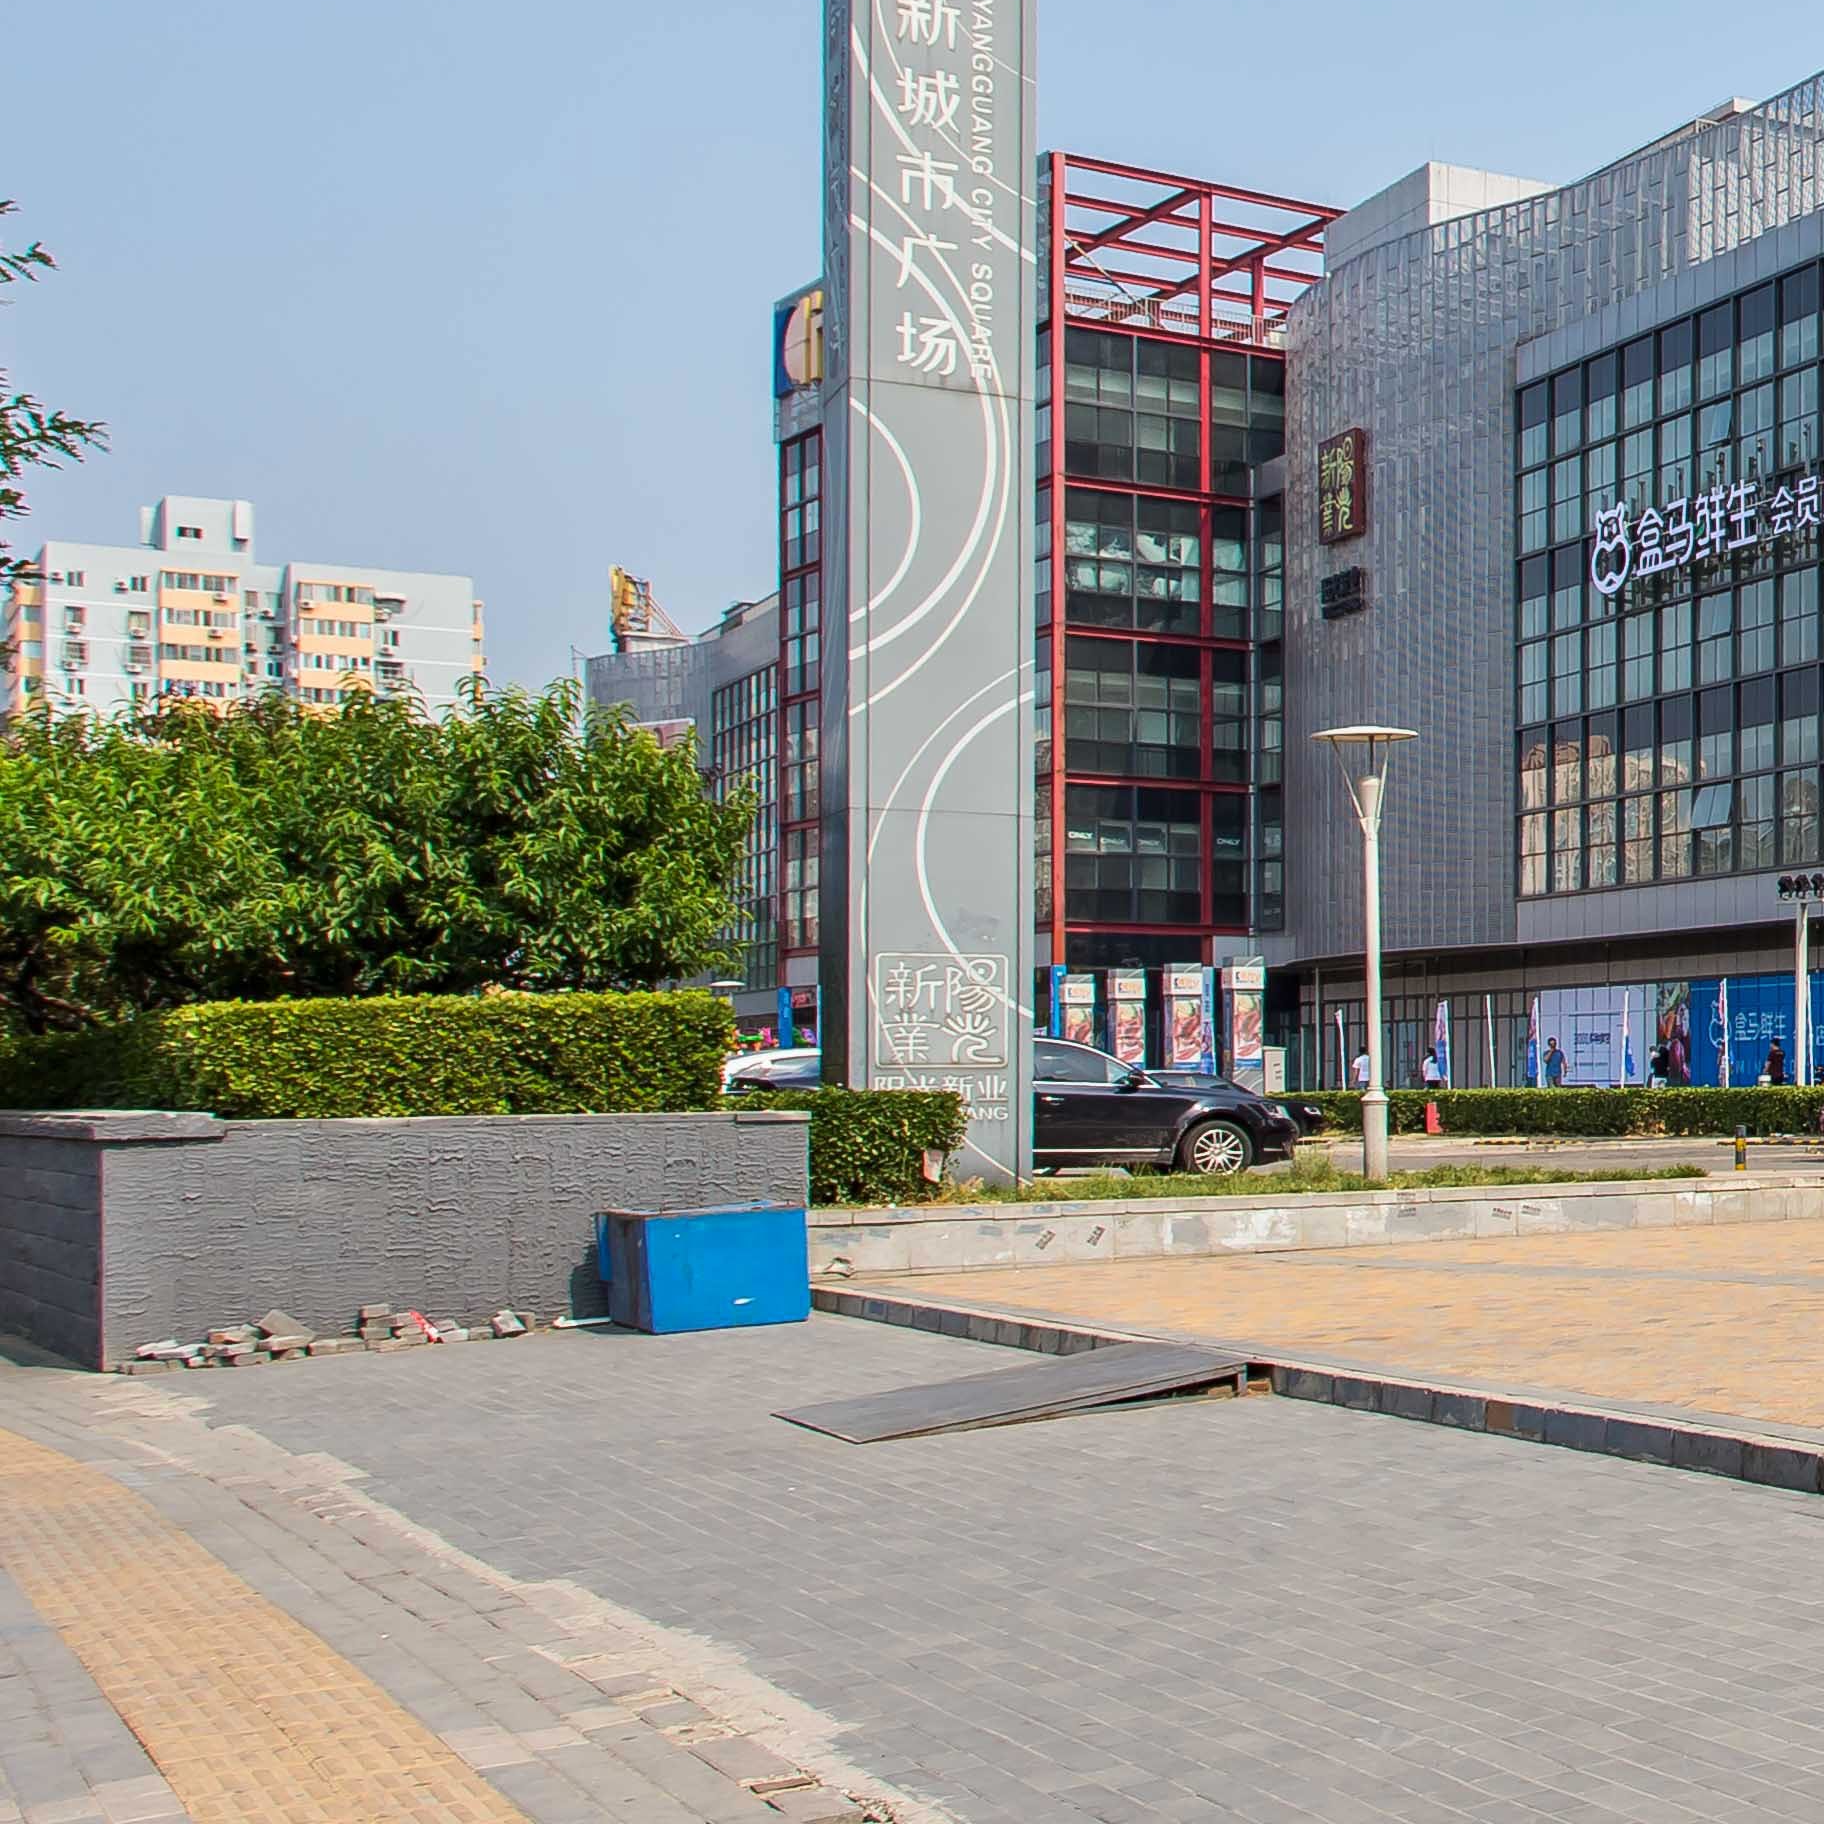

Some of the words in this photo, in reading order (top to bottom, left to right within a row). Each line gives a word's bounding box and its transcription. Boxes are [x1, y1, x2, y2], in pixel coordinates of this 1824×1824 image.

[970, 186, 993, 252] CITY
[970, 262, 993, 380] SQUARE
[1636, 478, 1758, 577] 盒马鲜生
[1734, 1011, 1787, 1042] 盒马鲜生
